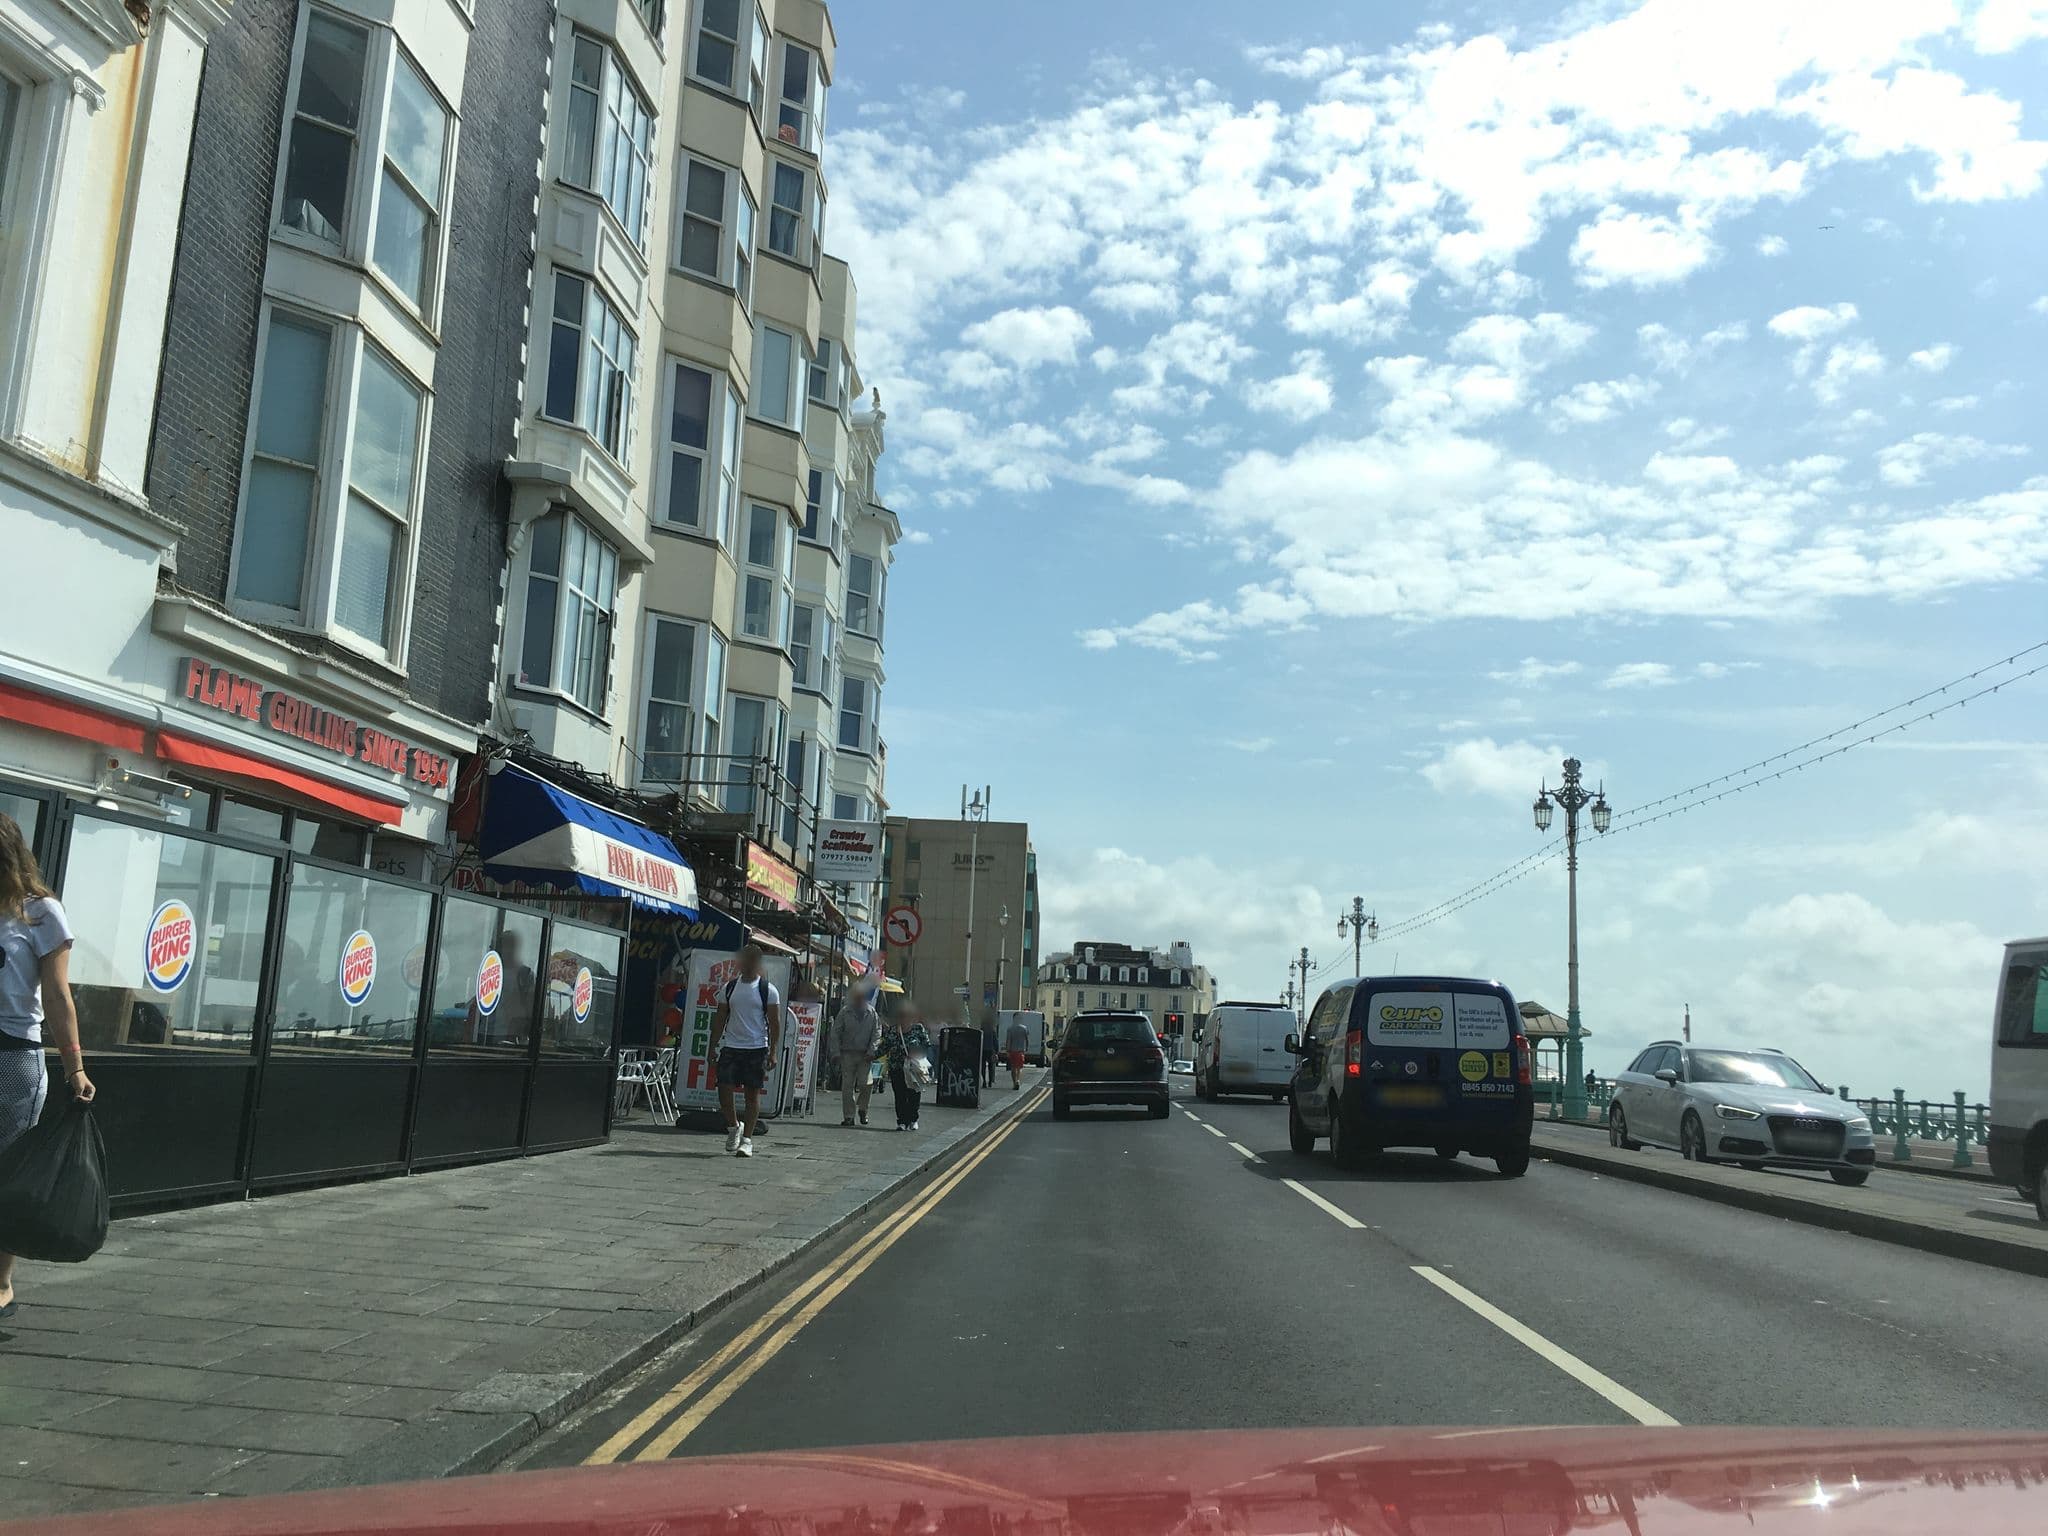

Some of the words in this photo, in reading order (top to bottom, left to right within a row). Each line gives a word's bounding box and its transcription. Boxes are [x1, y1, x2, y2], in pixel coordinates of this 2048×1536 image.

[186, 656, 264, 722] FLAME
[270, 690, 358, 758] GRILLING
[361, 727, 409, 776] SINCE
[412, 748, 450, 788] 1954
[605, 841, 636, 884] FISH
[636, 857, 646, 888] &
[643, 855, 679, 899] CHIPS
[151, 919, 192, 947] BURGER
[148, 933, 192, 973] KING
[344, 946, 374, 969] BURGER
[343, 957, 374, 989] KING
[479, 963, 501, 985] BURGER
[478, 974, 501, 998] KING
[1380, 1005, 1444, 1022] euro
[1381, 1022, 1404, 1030] CAR
[1406, 1022, 1441, 1031] PARTS
[1462, 1083, 1480, 1091] 0845
[1481, 1083, 1496, 1092] 850
